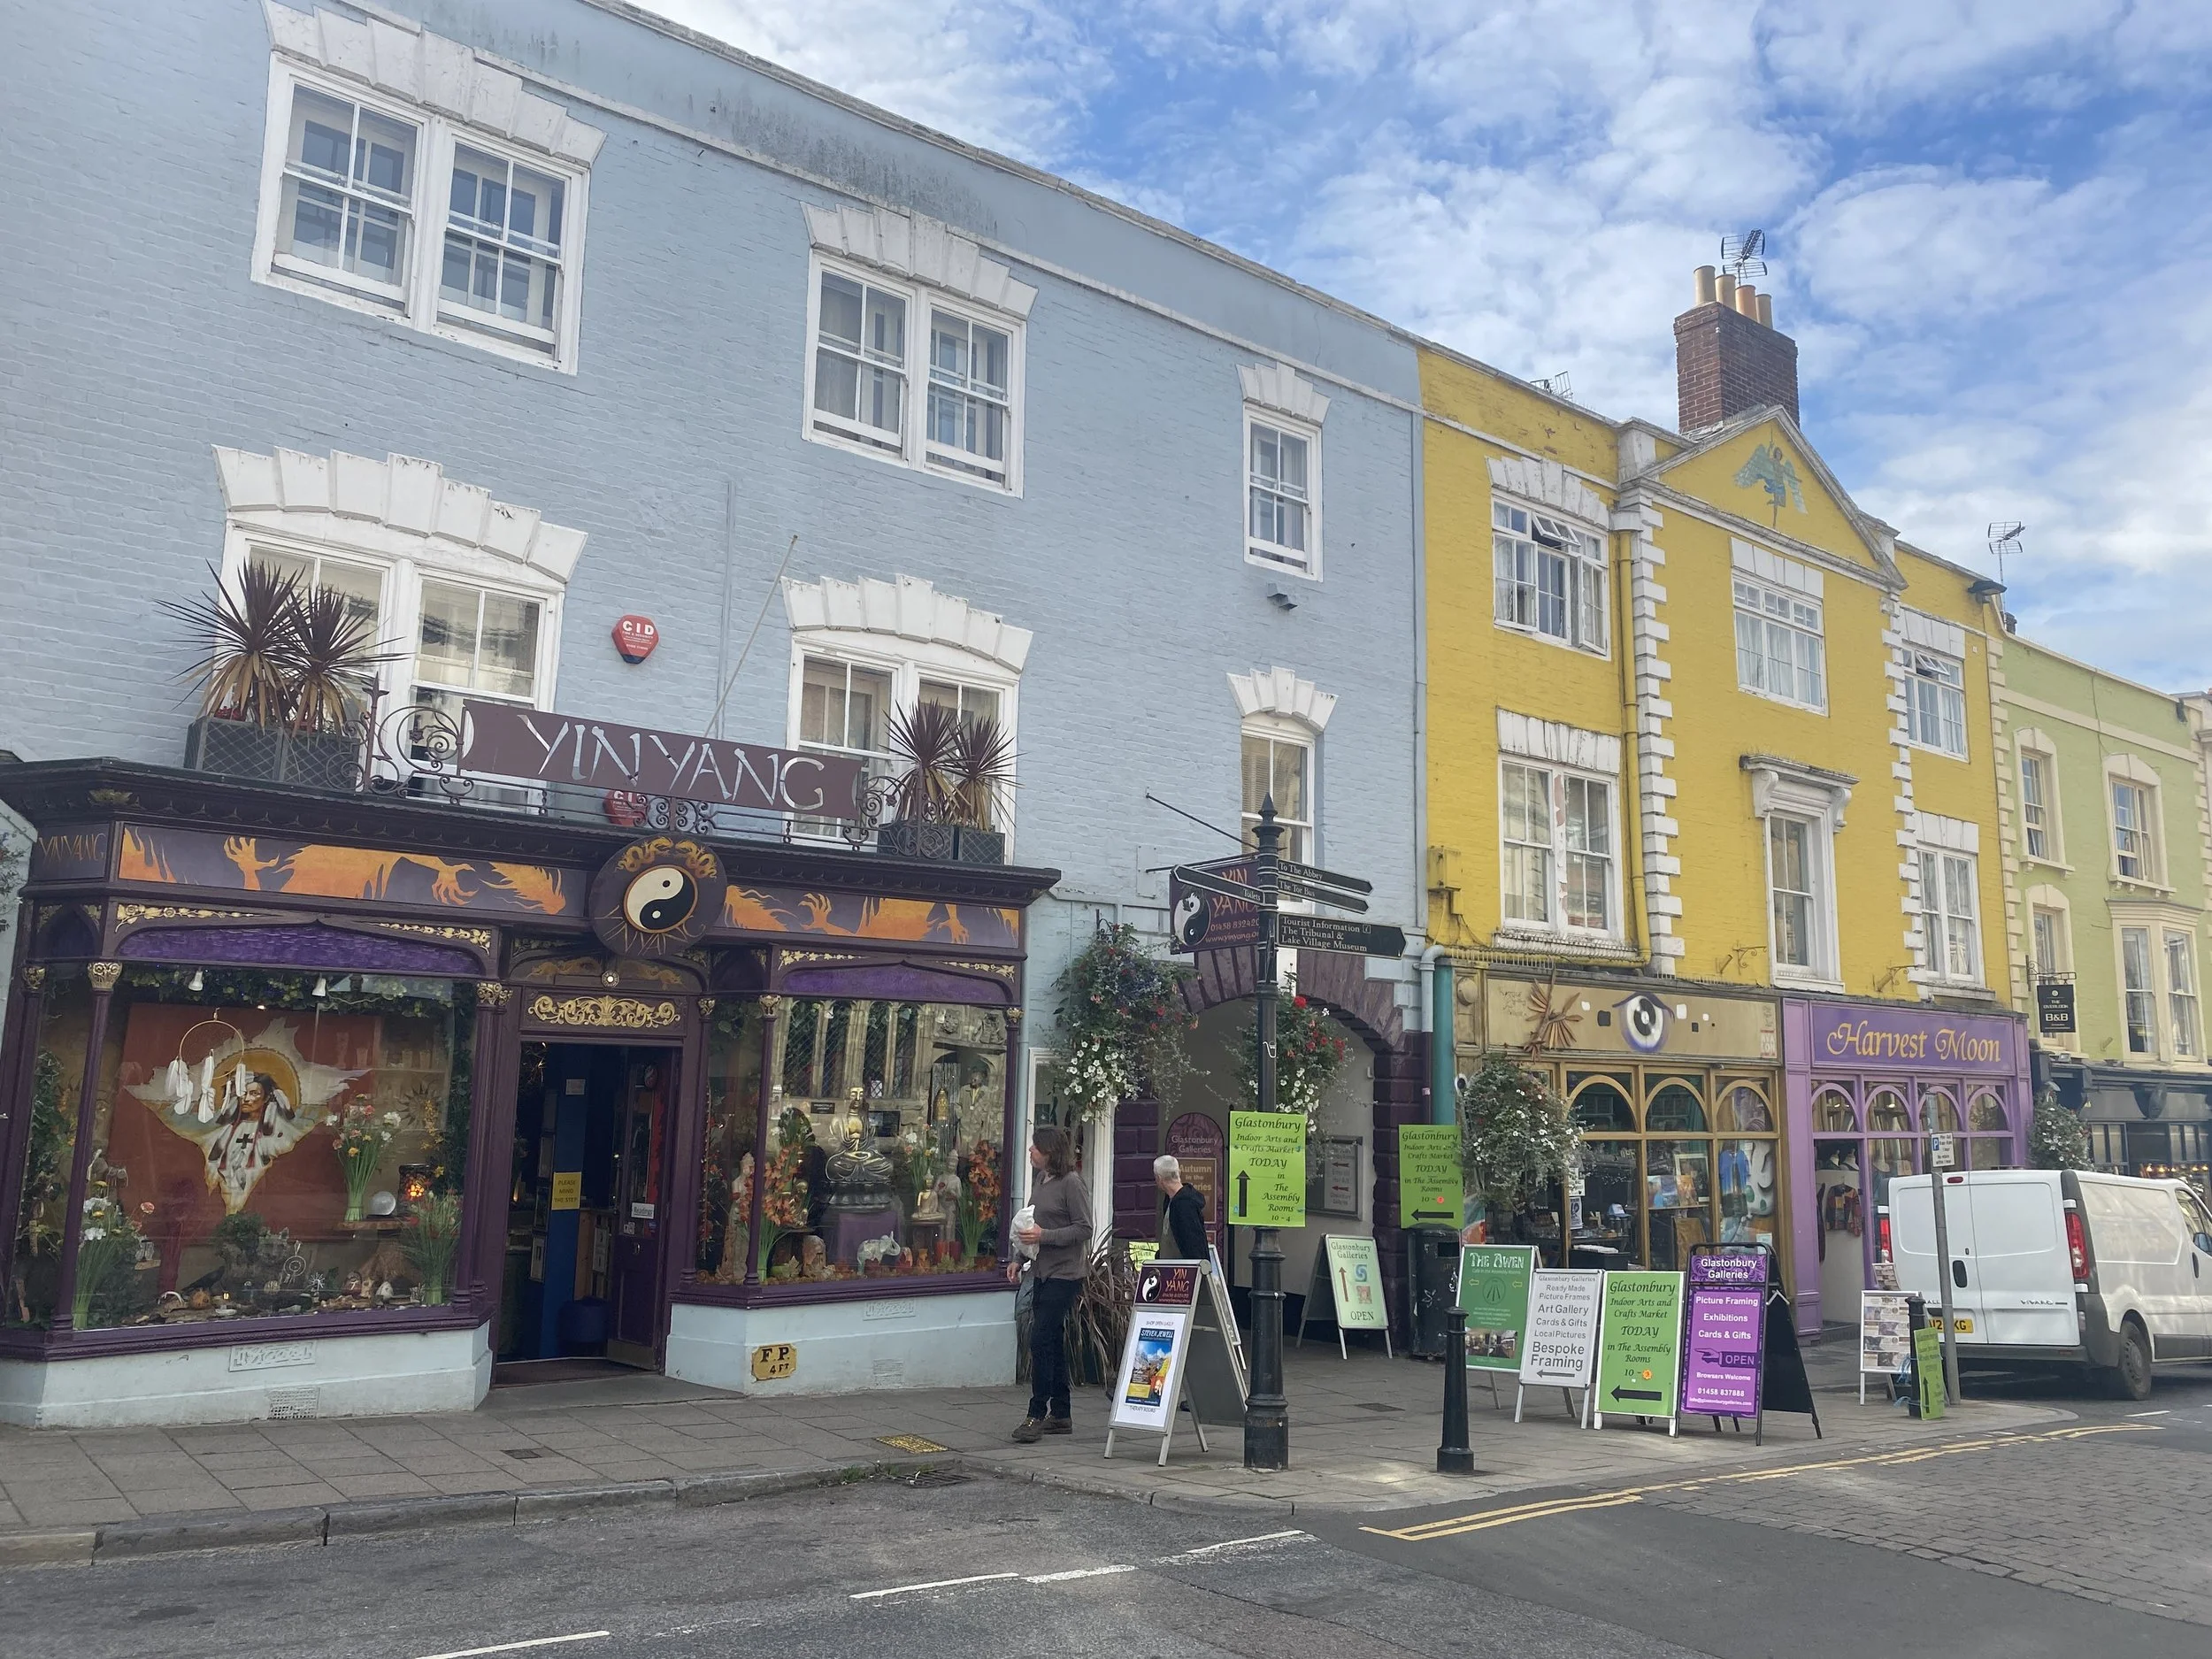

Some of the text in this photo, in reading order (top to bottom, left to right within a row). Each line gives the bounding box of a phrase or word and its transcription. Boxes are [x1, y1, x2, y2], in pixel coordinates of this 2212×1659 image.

[622, 620, 654, 635] CID
[1279, 863, 1323, 881] To The Abbey
[1279, 880, 1315, 896] The Tor Bus
[1243, 889, 1262, 901] Toilets
[1210, 922, 1231, 932] 01458
[1282, 917, 1360, 933] Tourist Information
[1282, 926, 1298, 935] The
[1300, 928, 1334, 939] Tribunal
[1282, 935, 1367, 952] Lake Village Museum
[2045, 1013, 2069, 1022] B&B
[1826, 1020, 2001, 1062] Harvest Moon
[1235, 1117, 1301, 1133] Glastonbury
[1171, 1135, 1217, 1146] Glastonbury
[1402, 1130, 1458, 1141] Glastonbury
[1240, 1144, 1294, 1154] Crafts Market
[1249, 1157, 1287, 1168] TODAY
[1179, 1164, 1212, 1173] Autumn
[1415, 1164, 1448, 1174] TODAY
[1274, 1183, 1288, 1192] The
[1262, 1193, 1300, 1203] Assembly
[1331, 1242, 1371, 1252] Glastonbury
[1337, 1250, 1368, 1259] Galleries
[1701, 1258, 1757, 1269] Glastonbury
[1173, 1268, 1187, 1279] YIN
[1708, 1270, 1748, 1279] Galleries
[1164, 1280, 1190, 1292] YANG
[1609, 1280, 1676, 1296] Glastonbury
[1609, 1297, 1636, 1306] Indoor
[1656, 1298, 1673, 1307] and
[1725, 1297, 1758, 1307] Framing
[1538, 1304, 1589, 1316] Art Gallery
[1614, 1309, 1668, 1320] Crafts Market
[1350, 1311, 1374, 1321] OPEN
[1703, 1313, 1748, 1322] Exhibitions
[1536, 1317, 1559, 1326] Cards
[1568, 1318, 1587, 1327] Gifts
[1621, 1325, 1660, 1339] TODAY
[1732, 1331, 1751, 1340] Gifts
[1532, 1341, 1585, 1356] Bespoke
[1617, 1342, 1632, 1351] The
[1633, 1343, 1671, 1356] Assembly
[1531, 1354, 1584, 1371] Framing
[1624, 1354, 1651, 1363] Rooms
[1725, 1355, 1755, 1364] OPEN
